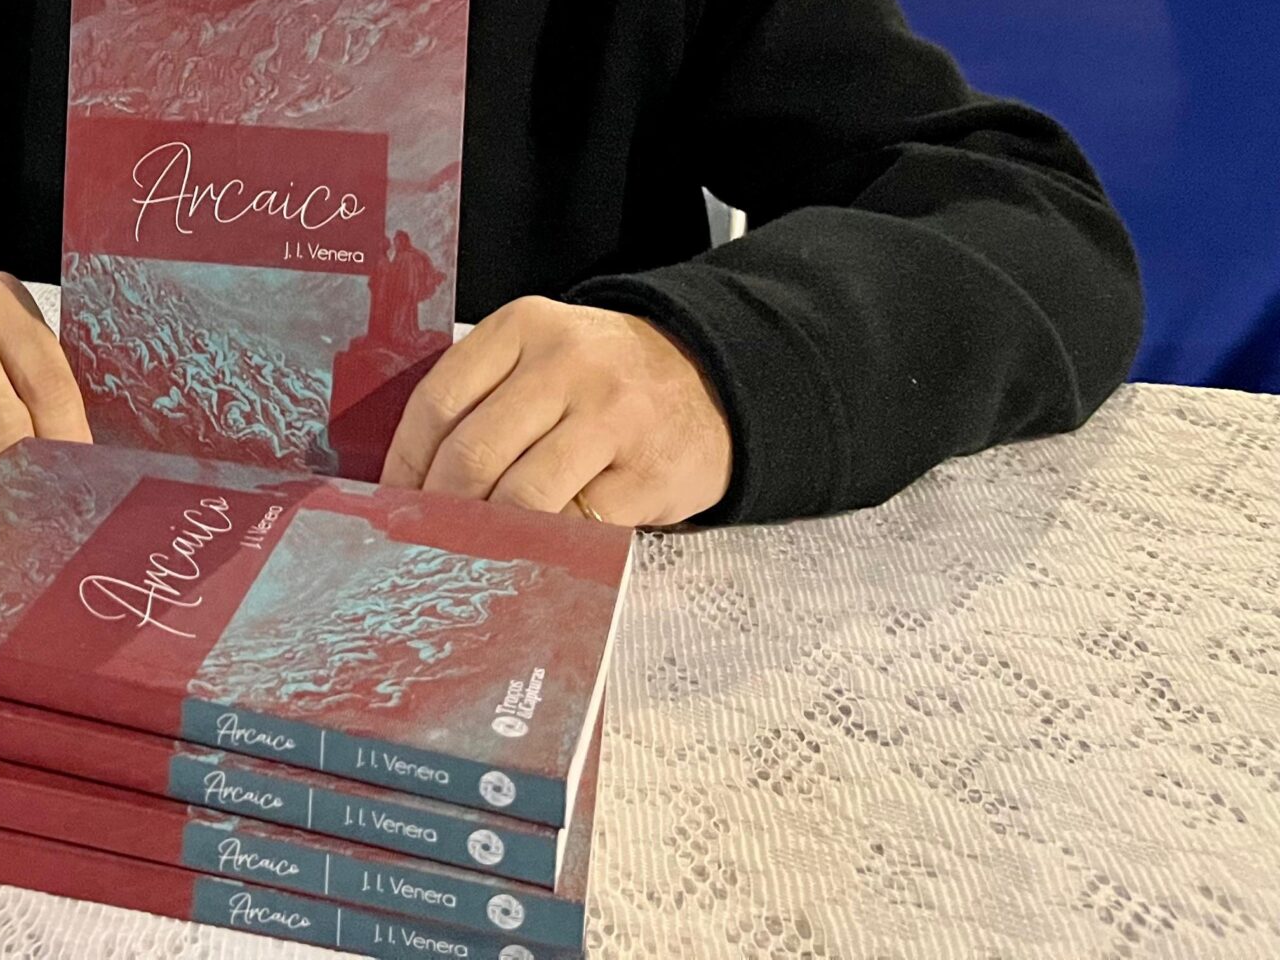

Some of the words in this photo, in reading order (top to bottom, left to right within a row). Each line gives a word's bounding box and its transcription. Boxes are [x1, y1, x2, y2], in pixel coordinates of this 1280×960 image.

[132, 141, 365, 242] Arcaico
[307, 242, 365, 263] Venera
[247, 505, 284, 535] Venera
[79, 496, 233, 638] Arcaico
[495, 679, 525, 714] Traços
[216, 713, 296, 750] Arcaico
[383, 753, 449, 784] Venera
[203, 771, 283, 809] Arcaico
[371, 810, 437, 842] Venera
[218, 838, 300, 876] Arcaico
[389, 876, 456, 908] Venera
[229, 892, 312, 930] Arcaico
[401, 928, 468, 957] Venera
